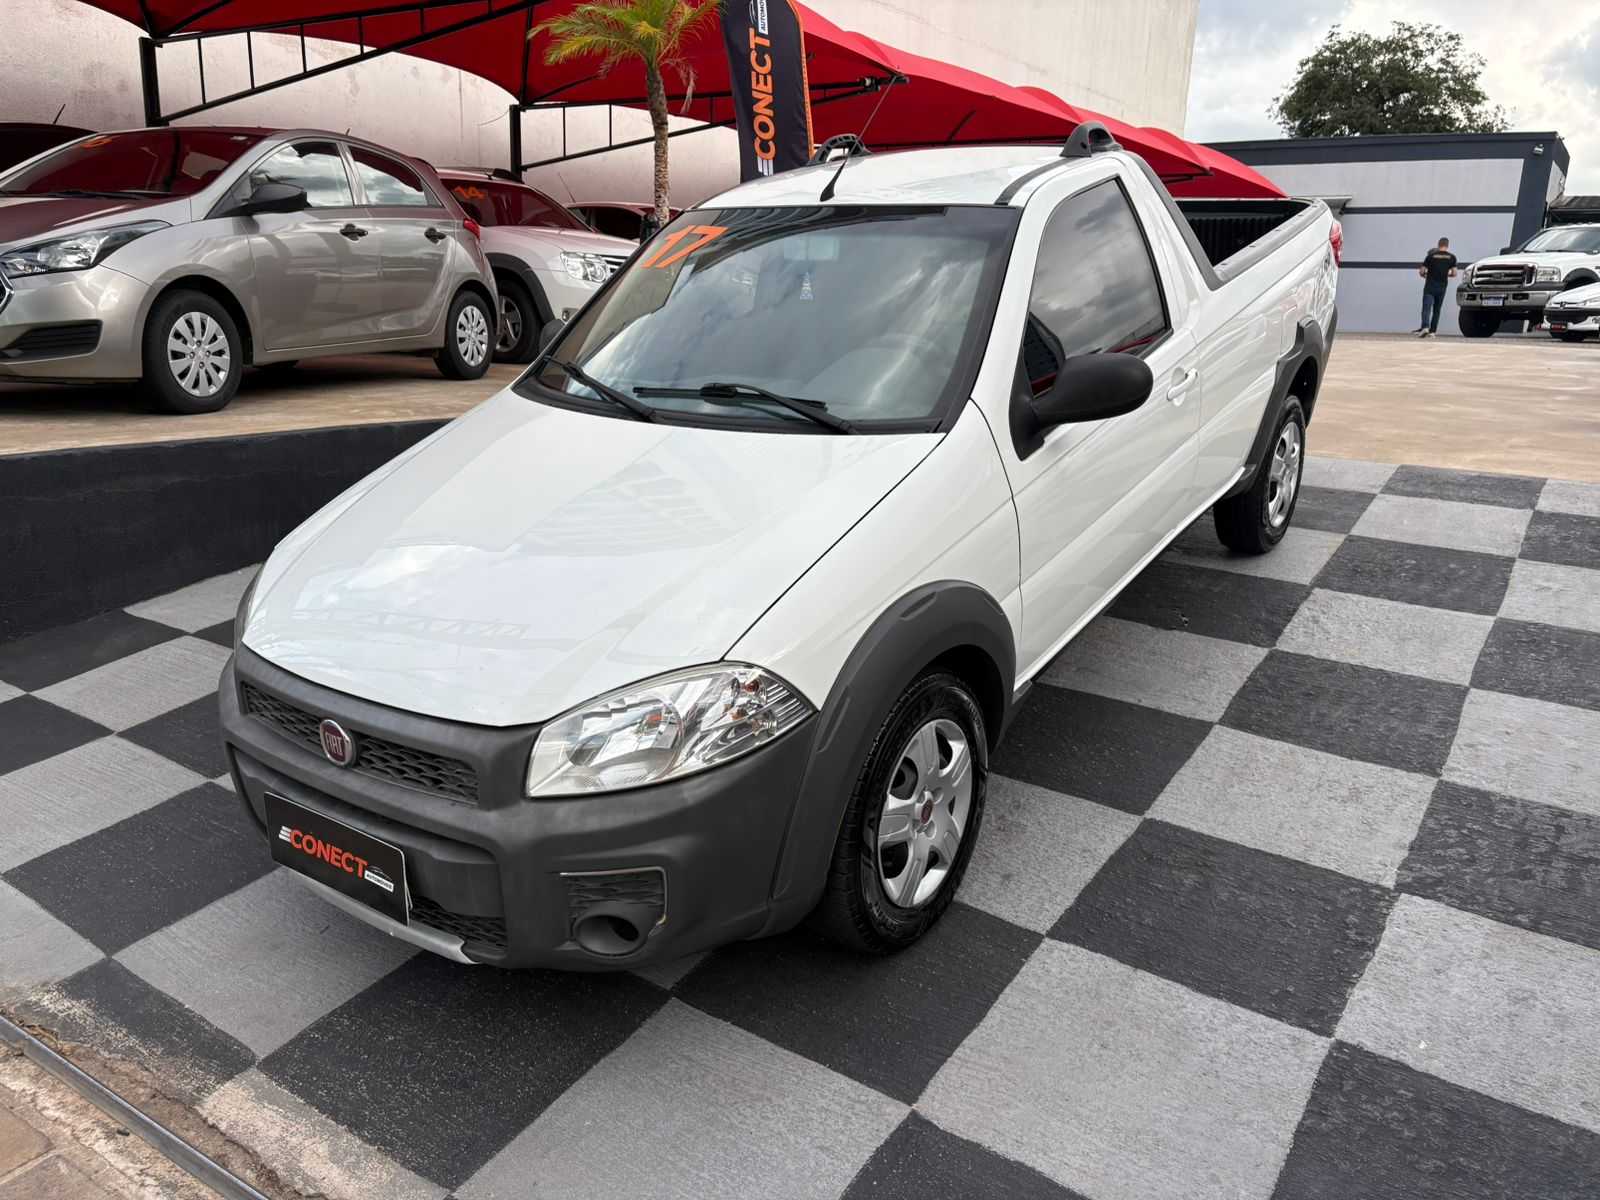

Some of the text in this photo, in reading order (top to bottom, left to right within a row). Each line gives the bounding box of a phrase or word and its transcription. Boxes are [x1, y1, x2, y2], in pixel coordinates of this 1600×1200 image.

[749, 27, 776, 161] CONECT
[641, 225, 729, 269] 17
[325, 732, 344, 755] FIAT
[289, 829, 368, 878] CONECT
